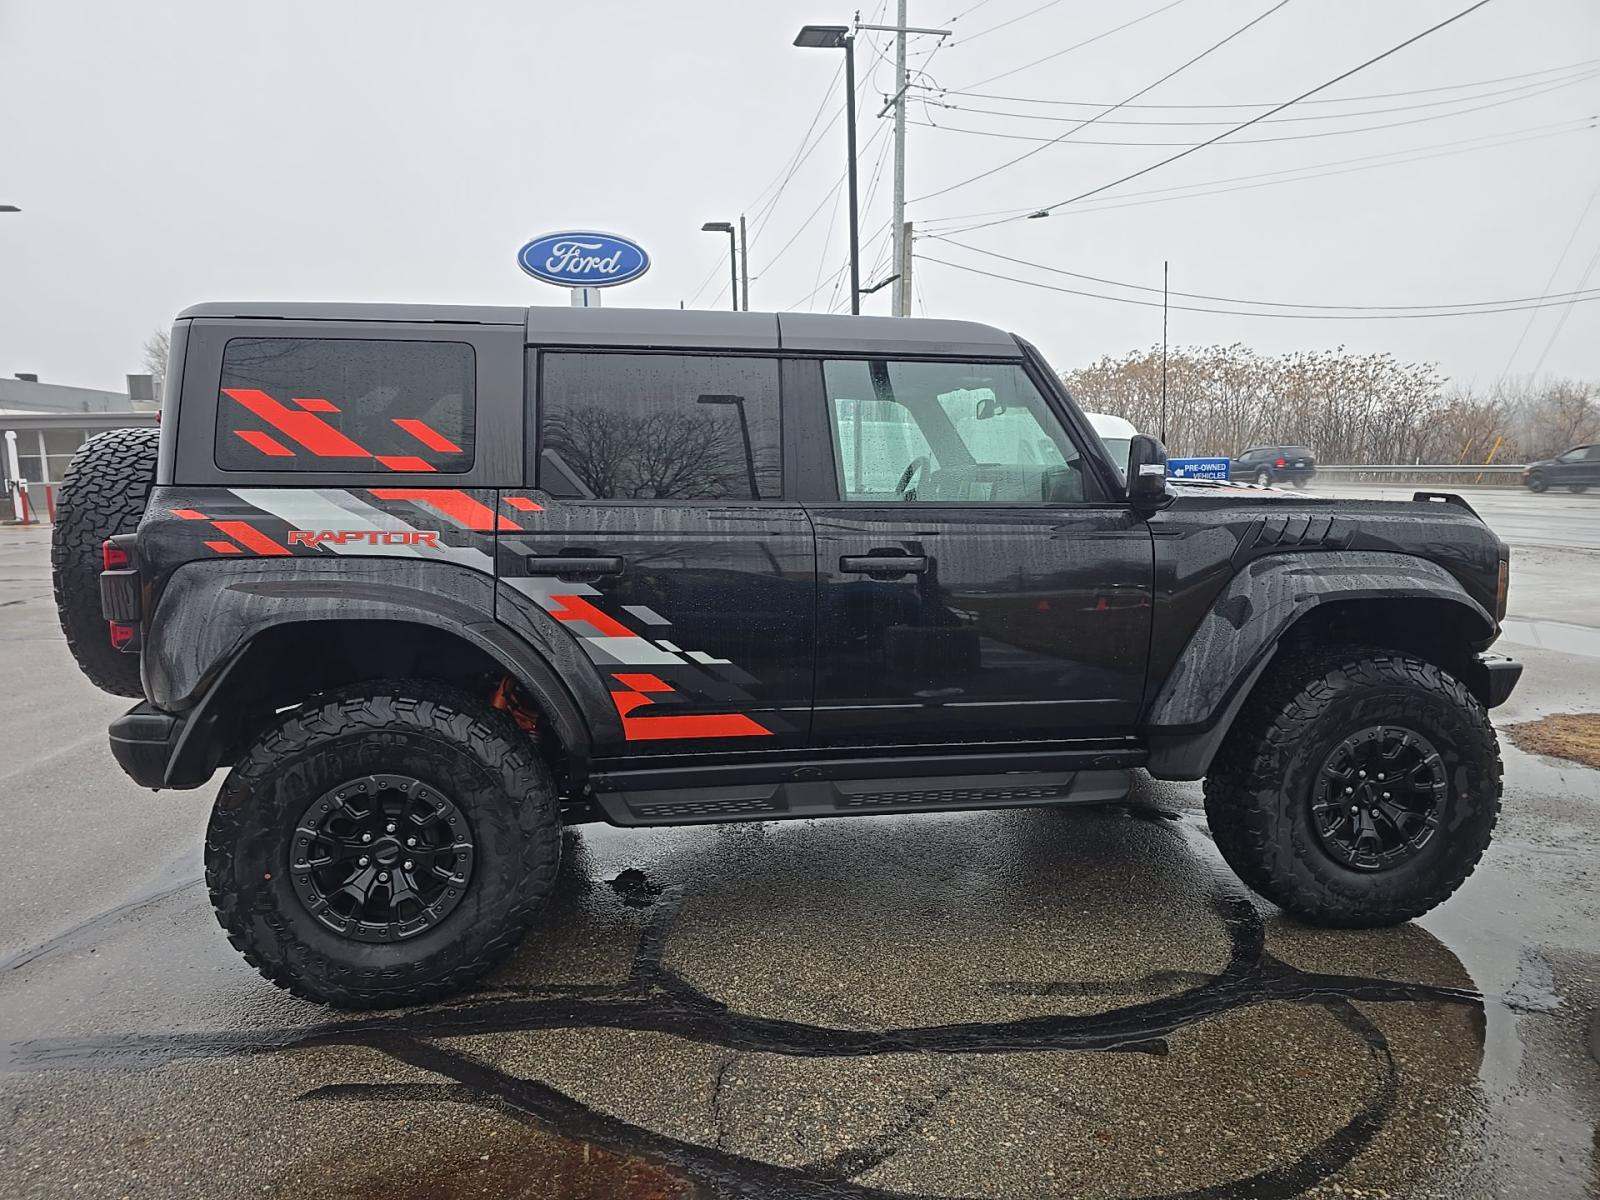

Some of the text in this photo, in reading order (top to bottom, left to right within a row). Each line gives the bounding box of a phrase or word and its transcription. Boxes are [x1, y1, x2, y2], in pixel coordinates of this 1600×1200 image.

[545, 241, 622, 273] Ford
[1184, 464, 1227, 472] PRE-OWNED
[1193, 472, 1226, 480] VEHICLES
[288, 530, 443, 553] RAPTOR
